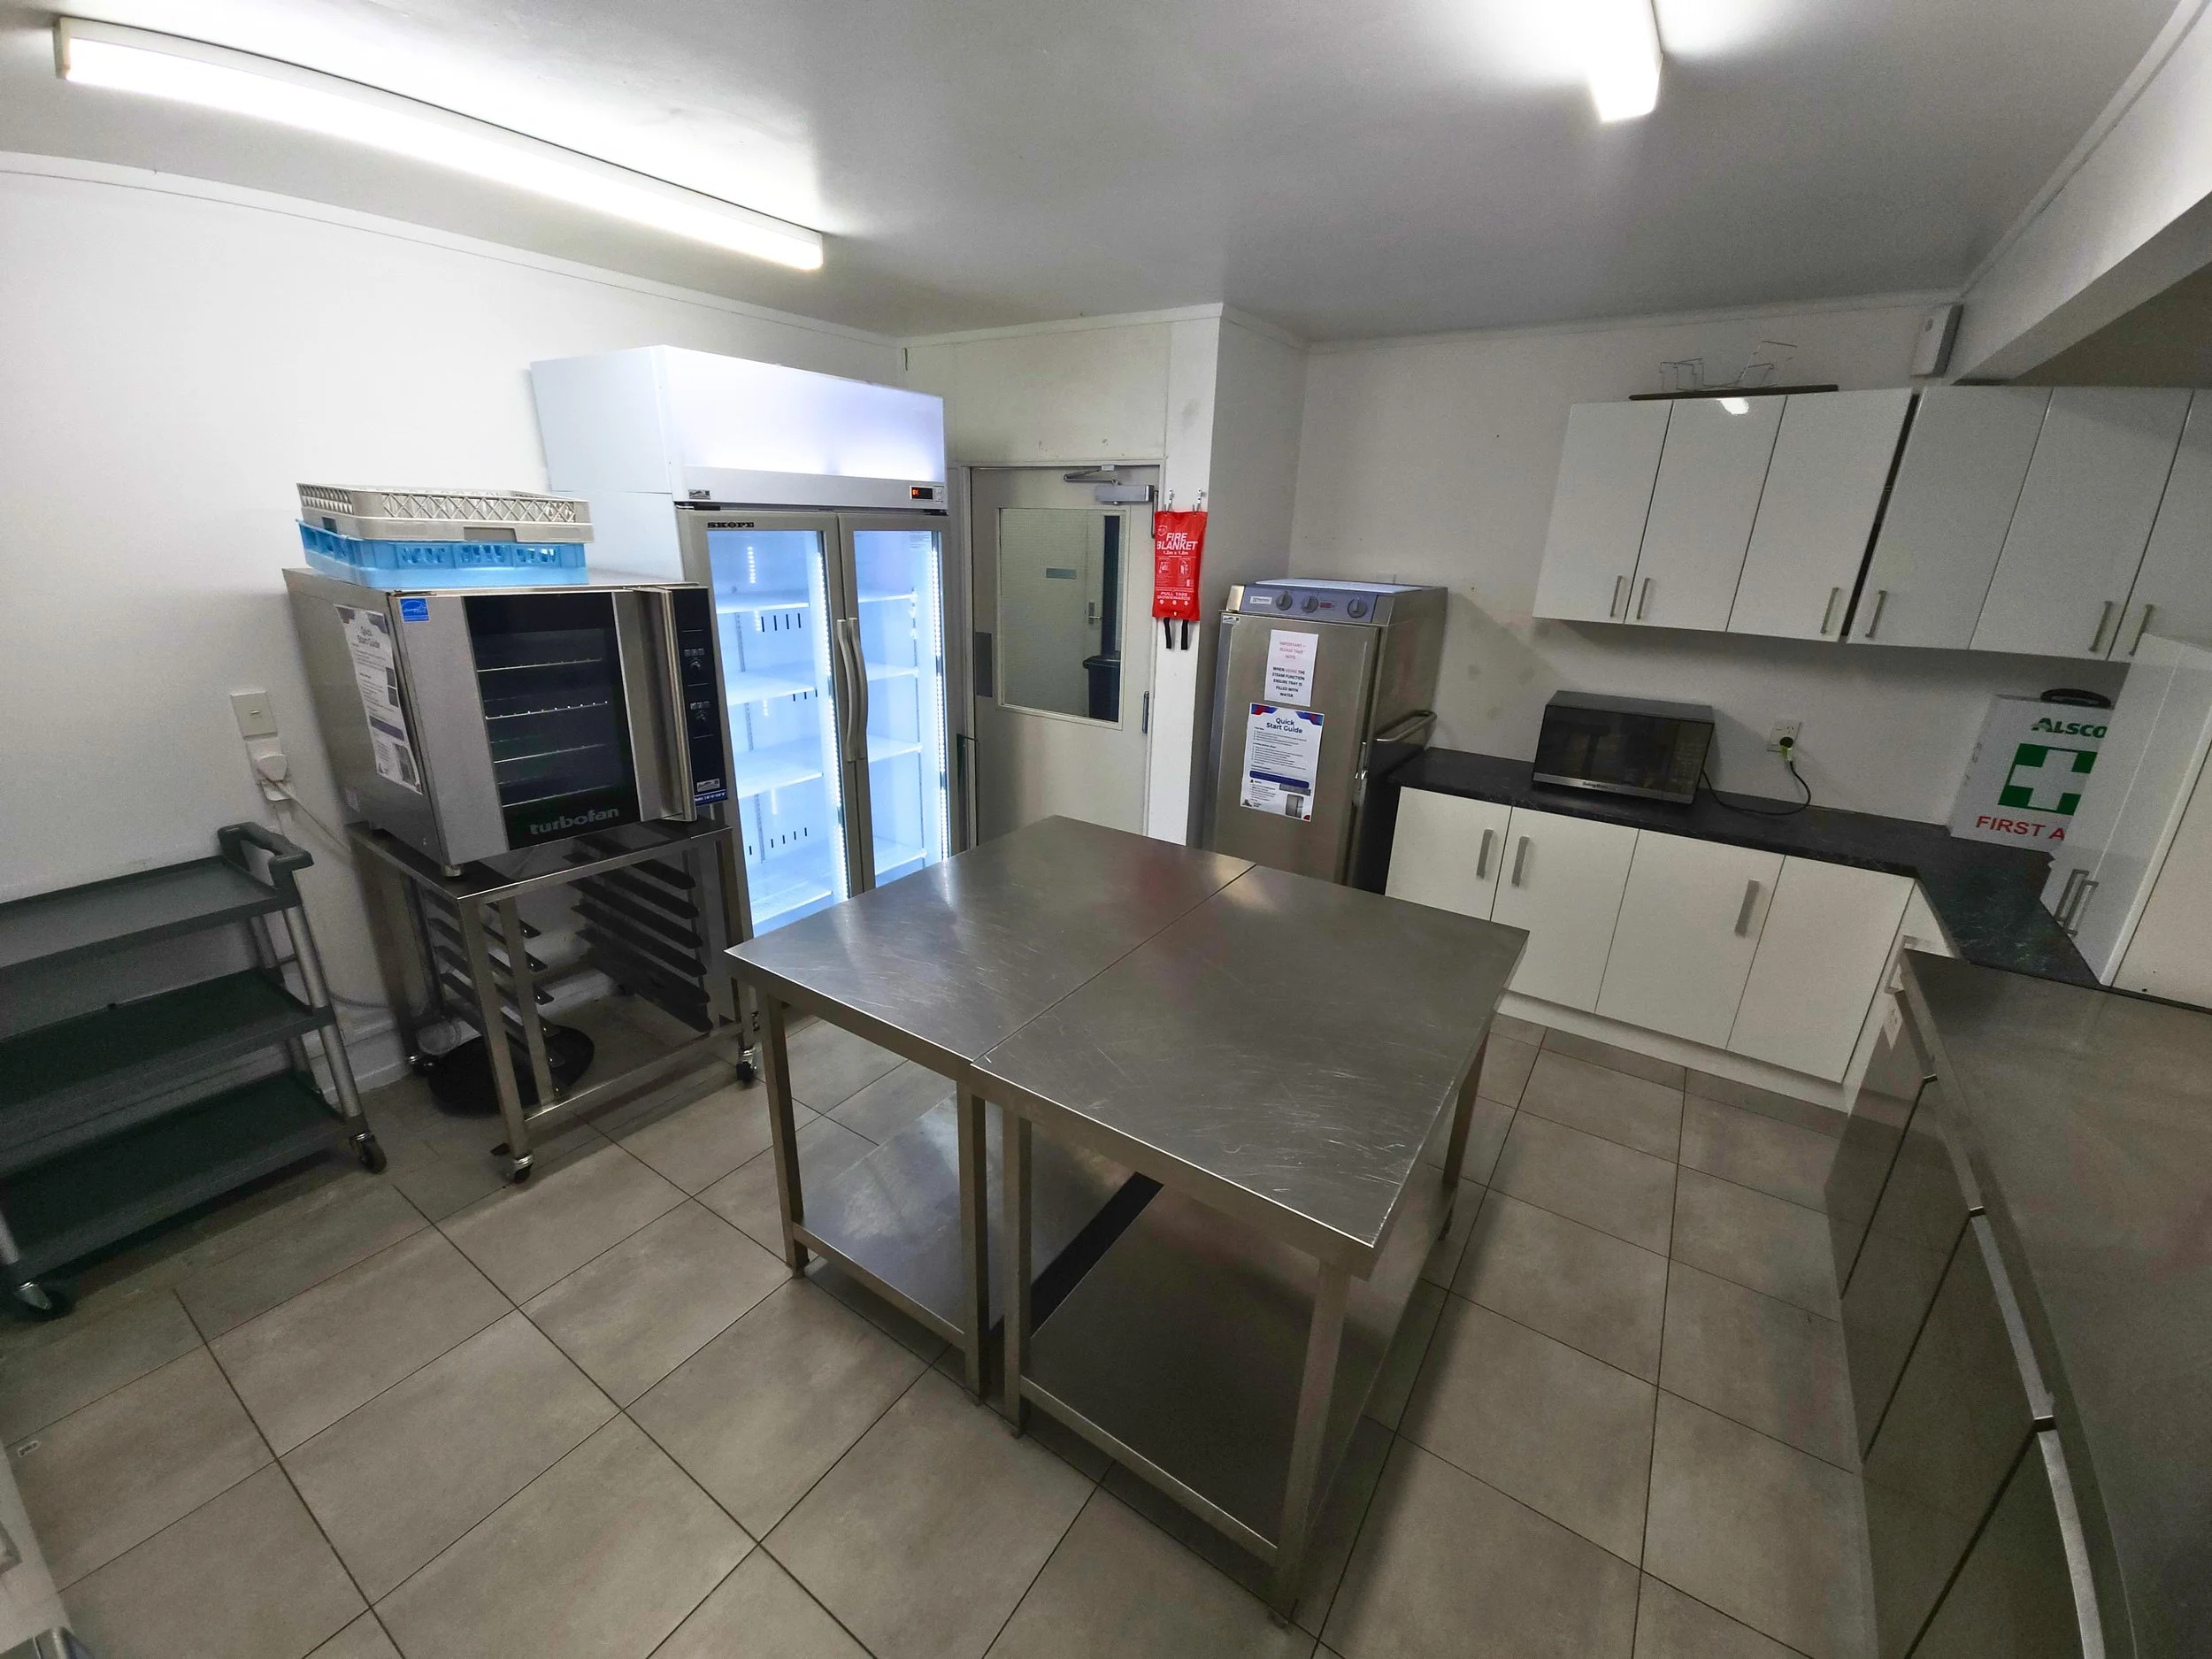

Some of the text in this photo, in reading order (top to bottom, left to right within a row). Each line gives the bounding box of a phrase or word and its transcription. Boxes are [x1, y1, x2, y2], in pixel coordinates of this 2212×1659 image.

[1166, 532, 1188, 541] FIRE
[1156, 541, 1198, 550] BLANKET
[1266, 722, 1282, 731] Start
[2031, 718, 2108, 739] ALSCO
[529, 808, 619, 834] turbofan
[1975, 815, 2047, 837] FIRST
